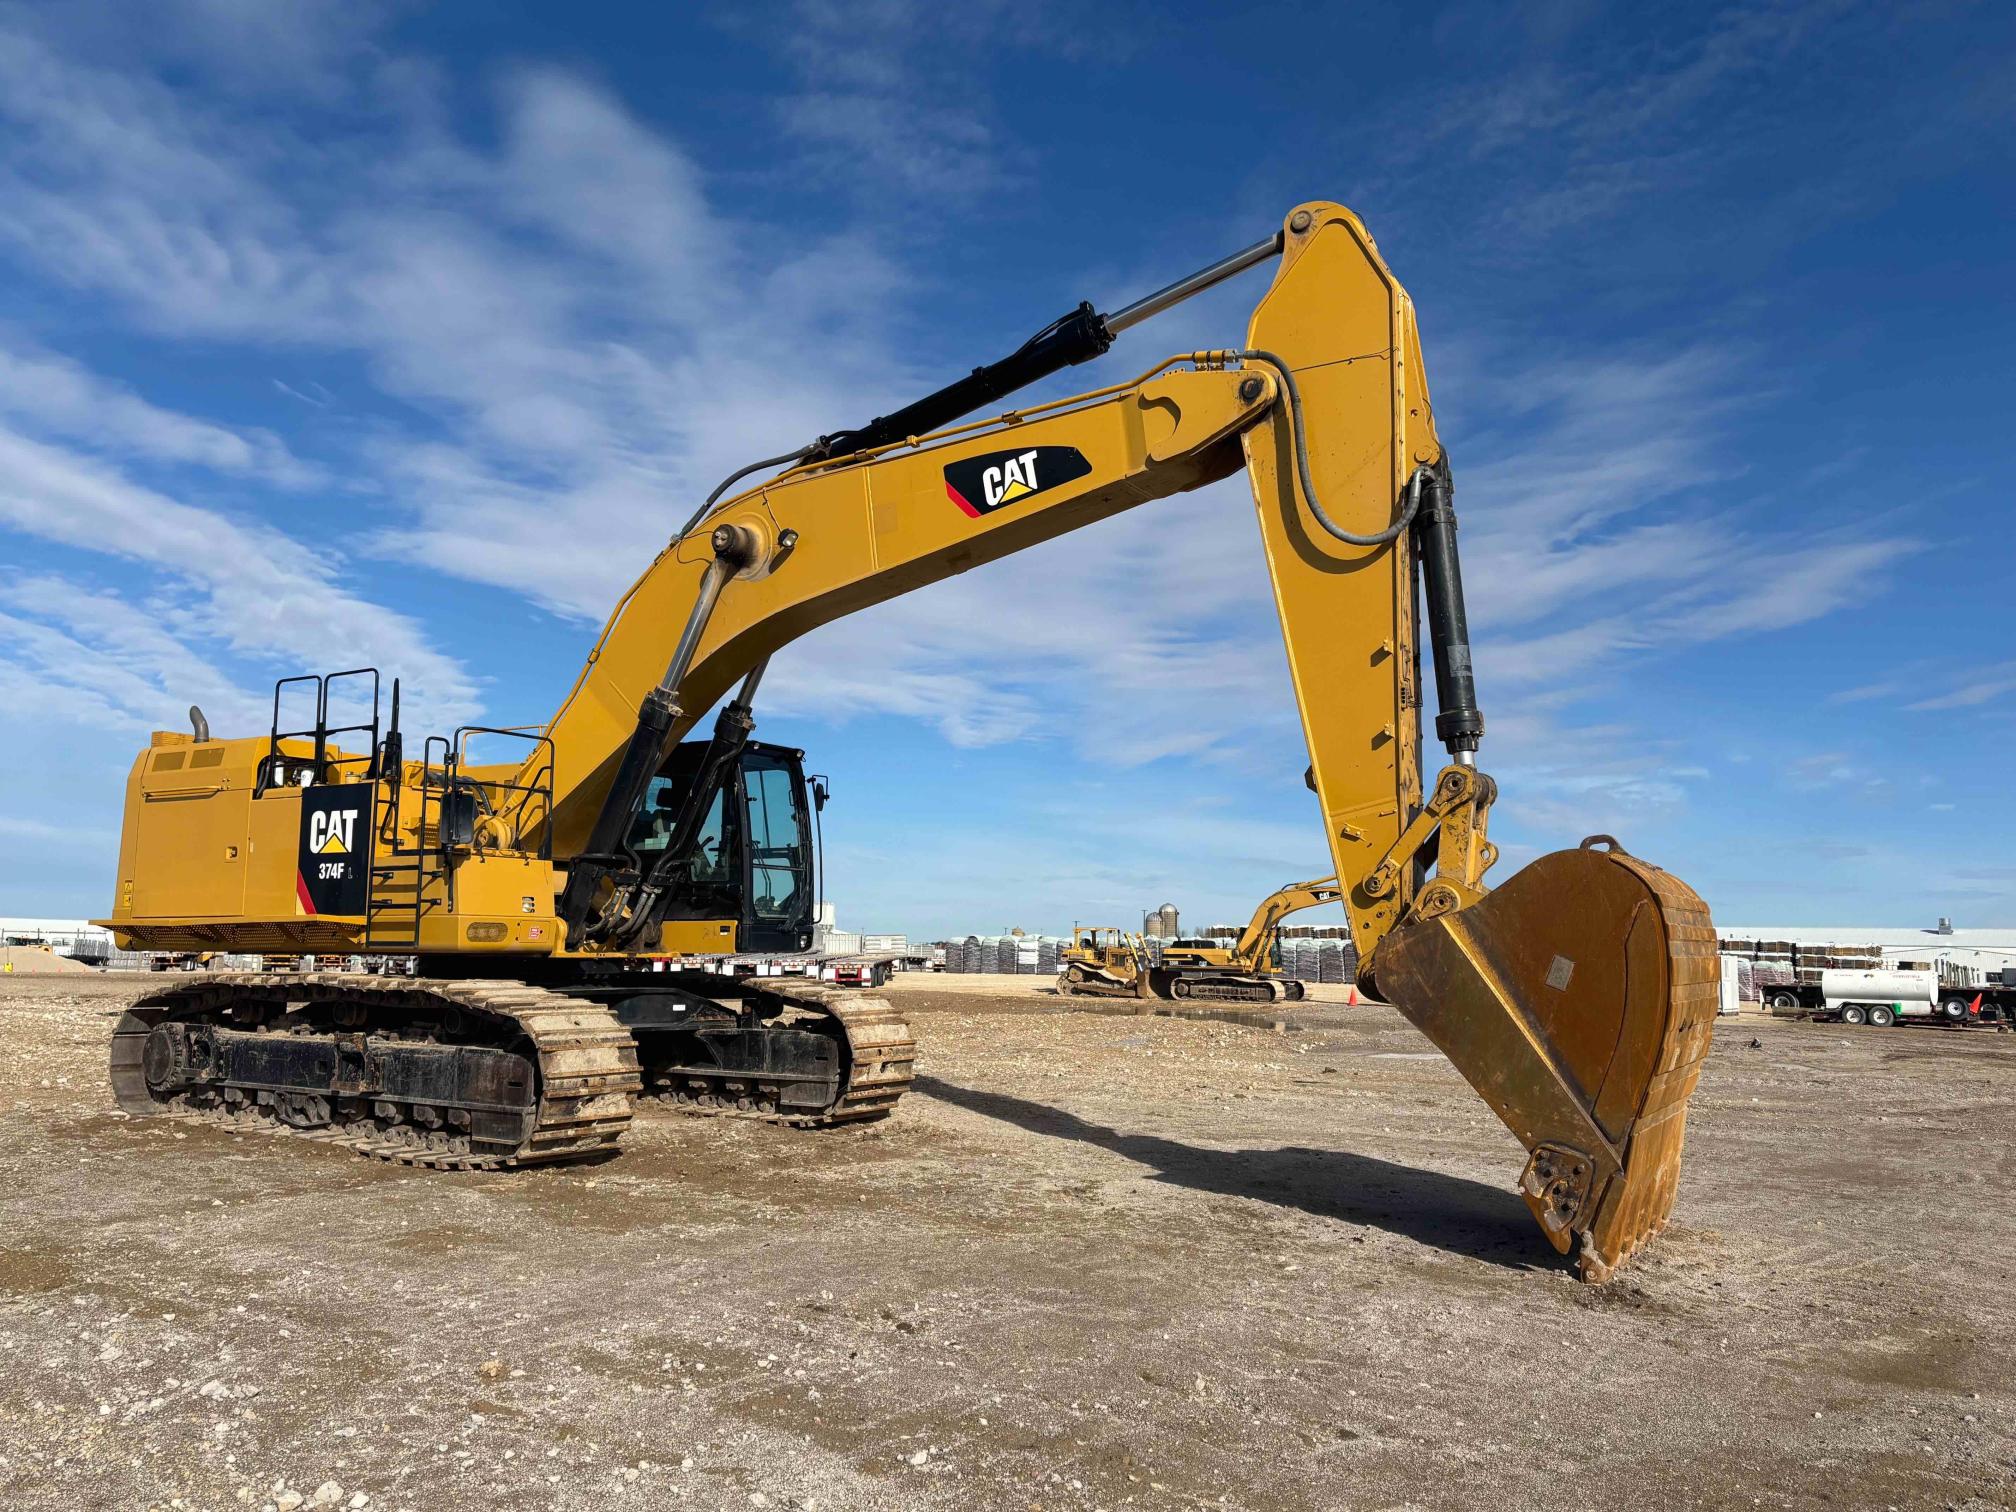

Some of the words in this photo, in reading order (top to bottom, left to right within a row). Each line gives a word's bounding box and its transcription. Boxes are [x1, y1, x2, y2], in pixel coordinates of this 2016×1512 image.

[982, 450, 1038, 506] CAT
[310, 809, 358, 854] CAT
[318, 862, 345, 880] 374F
